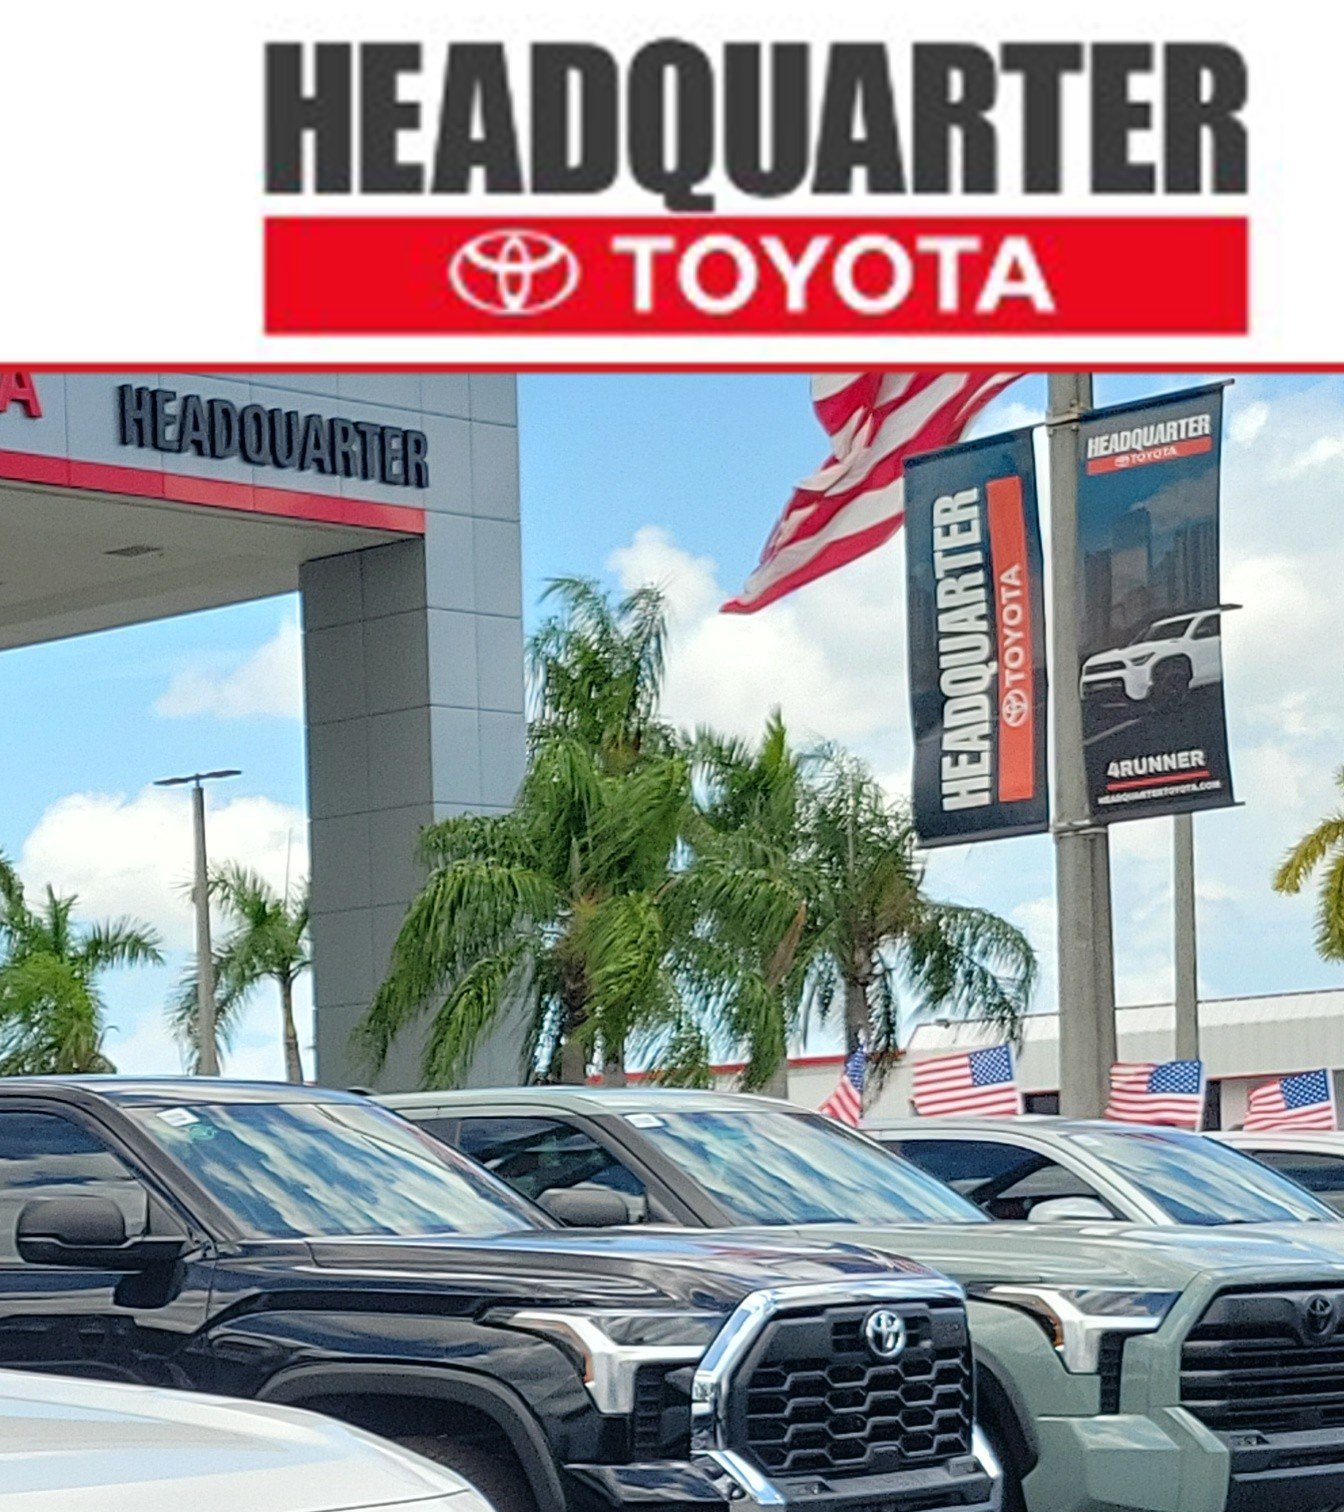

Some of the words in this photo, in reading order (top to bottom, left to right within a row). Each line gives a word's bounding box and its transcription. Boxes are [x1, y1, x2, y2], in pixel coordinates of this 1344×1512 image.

[117, 384, 429, 488] HEADQUARTER
[1087, 414, 1211, 459] HEADQUARTER
[1132, 446, 1178, 464] TOYOTA
[932, 486, 996, 811] HEADQUARTER
[999, 563, 1028, 686] TOYOTA
[1107, 749, 1206, 778] 4RUNNER
